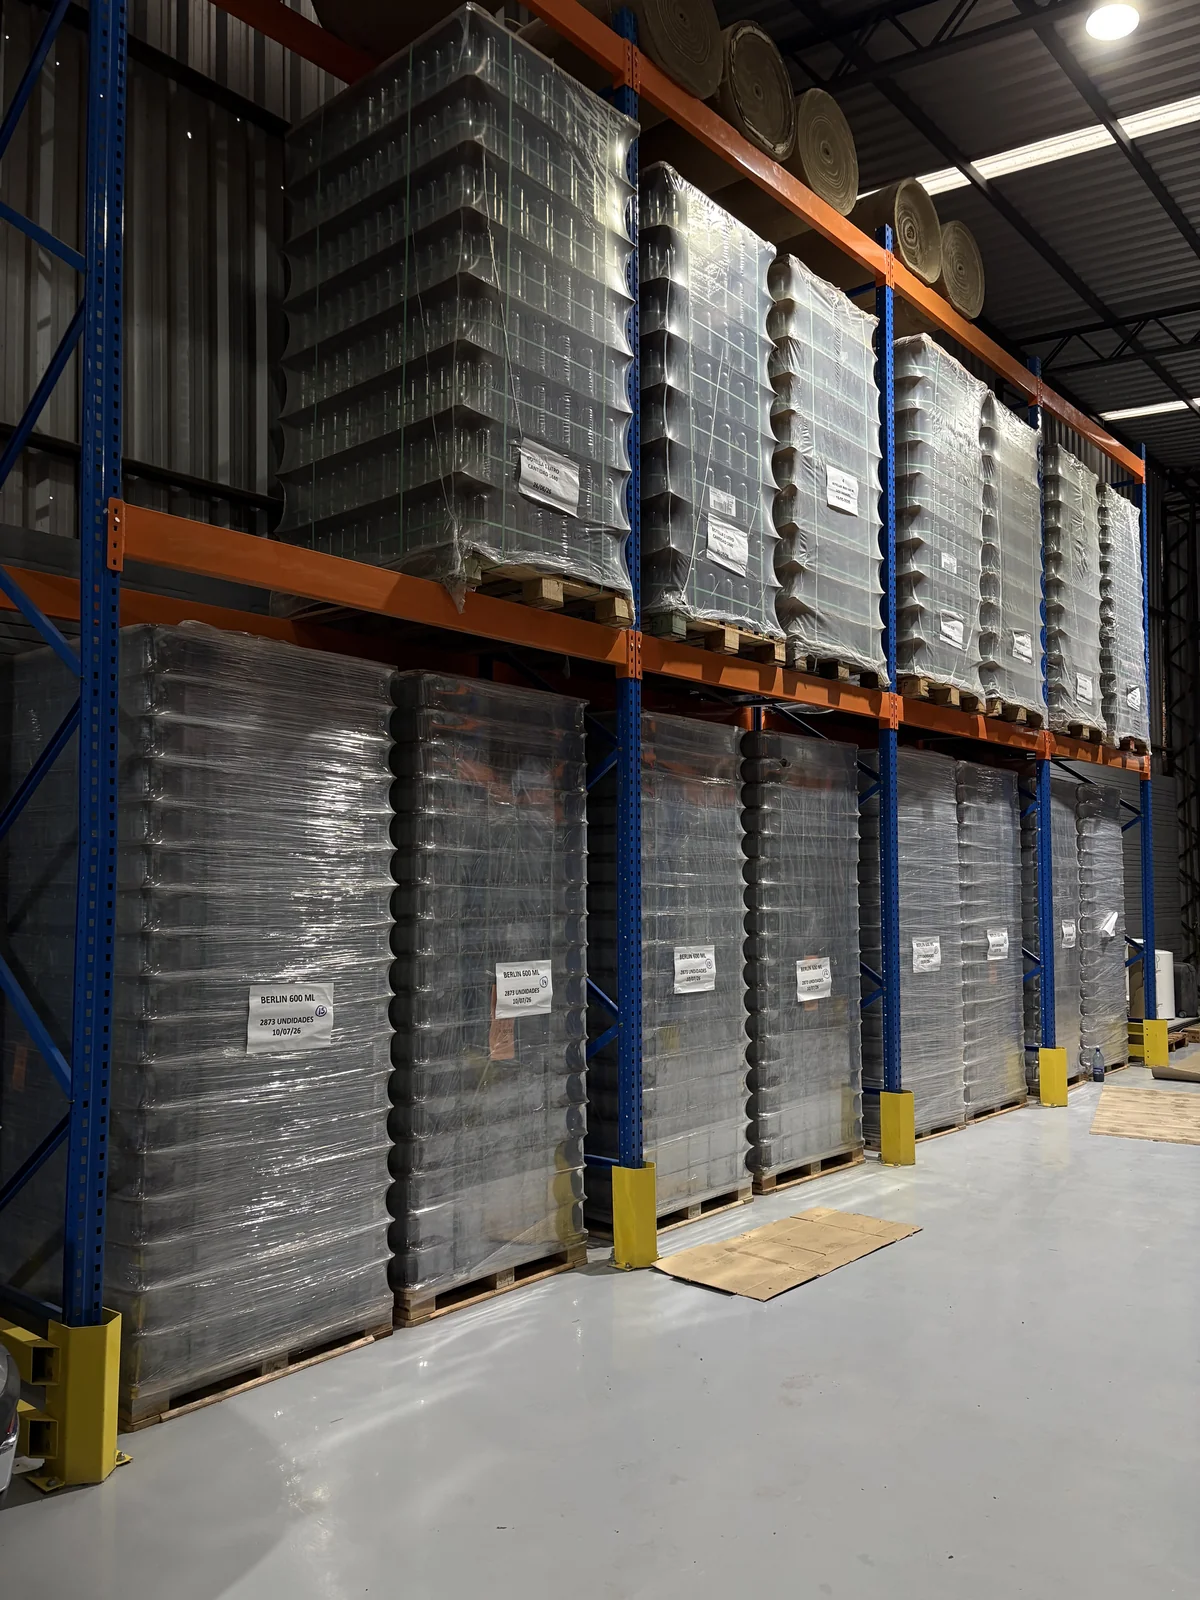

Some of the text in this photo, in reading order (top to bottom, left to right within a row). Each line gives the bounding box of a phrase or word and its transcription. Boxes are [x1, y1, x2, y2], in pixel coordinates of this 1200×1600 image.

[503, 971, 522, 979] BERLIN
[521, 969, 532, 977] 600
[504, 989, 515, 997] 2873
[260, 993, 316, 1004] BERLIN 600 ML
[259, 1015, 315, 1026] 2873 UNDIDADES
[272, 1027, 302, 1037] 10/07/26
